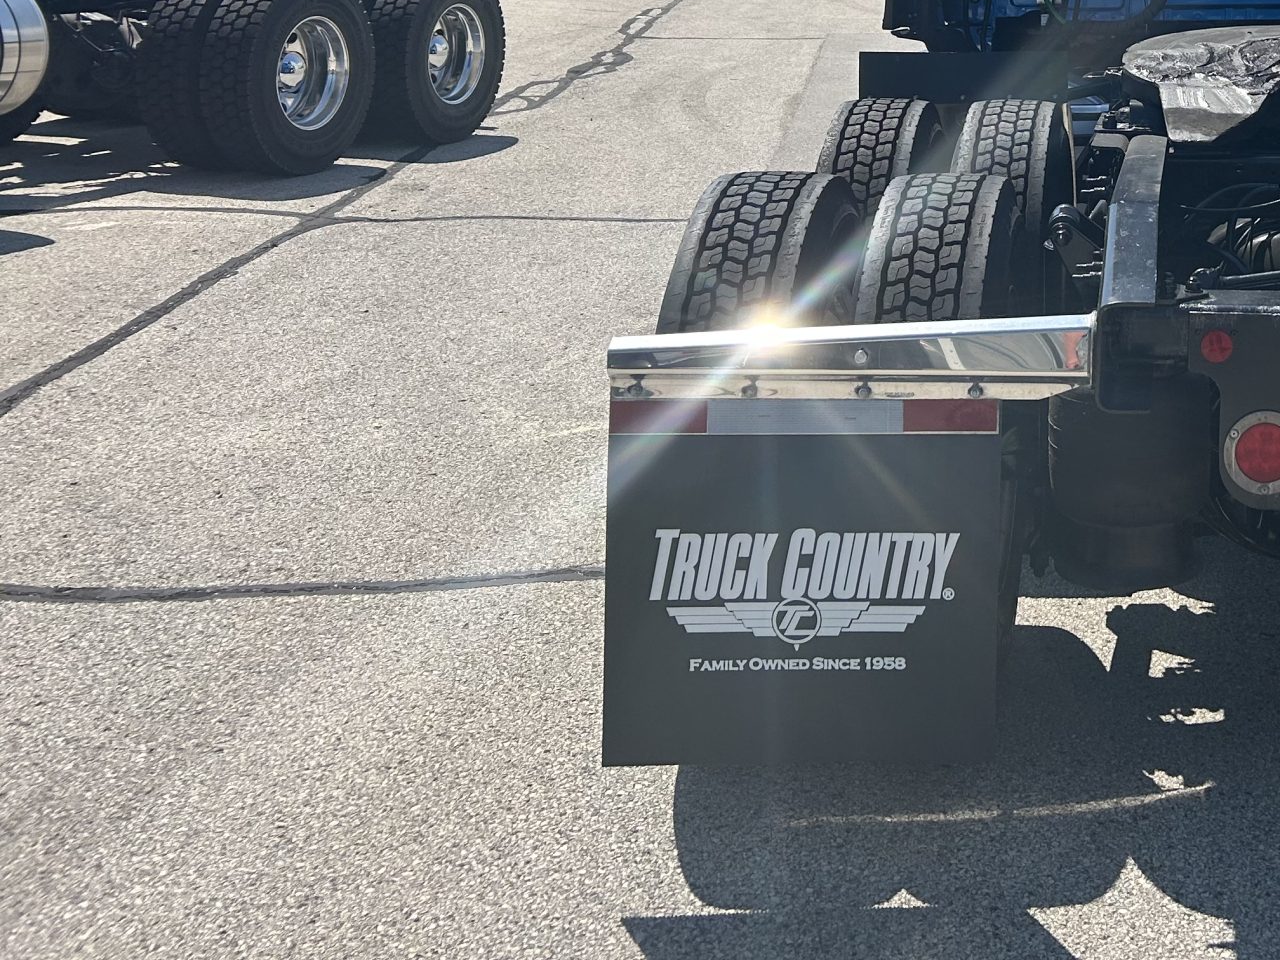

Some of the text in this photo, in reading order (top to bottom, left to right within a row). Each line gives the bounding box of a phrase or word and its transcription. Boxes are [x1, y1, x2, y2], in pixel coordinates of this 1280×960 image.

[648, 528, 961, 601] TRUCK COUNTRY
[689, 656, 907, 672] FAMILY OWNED SINCE 1958
